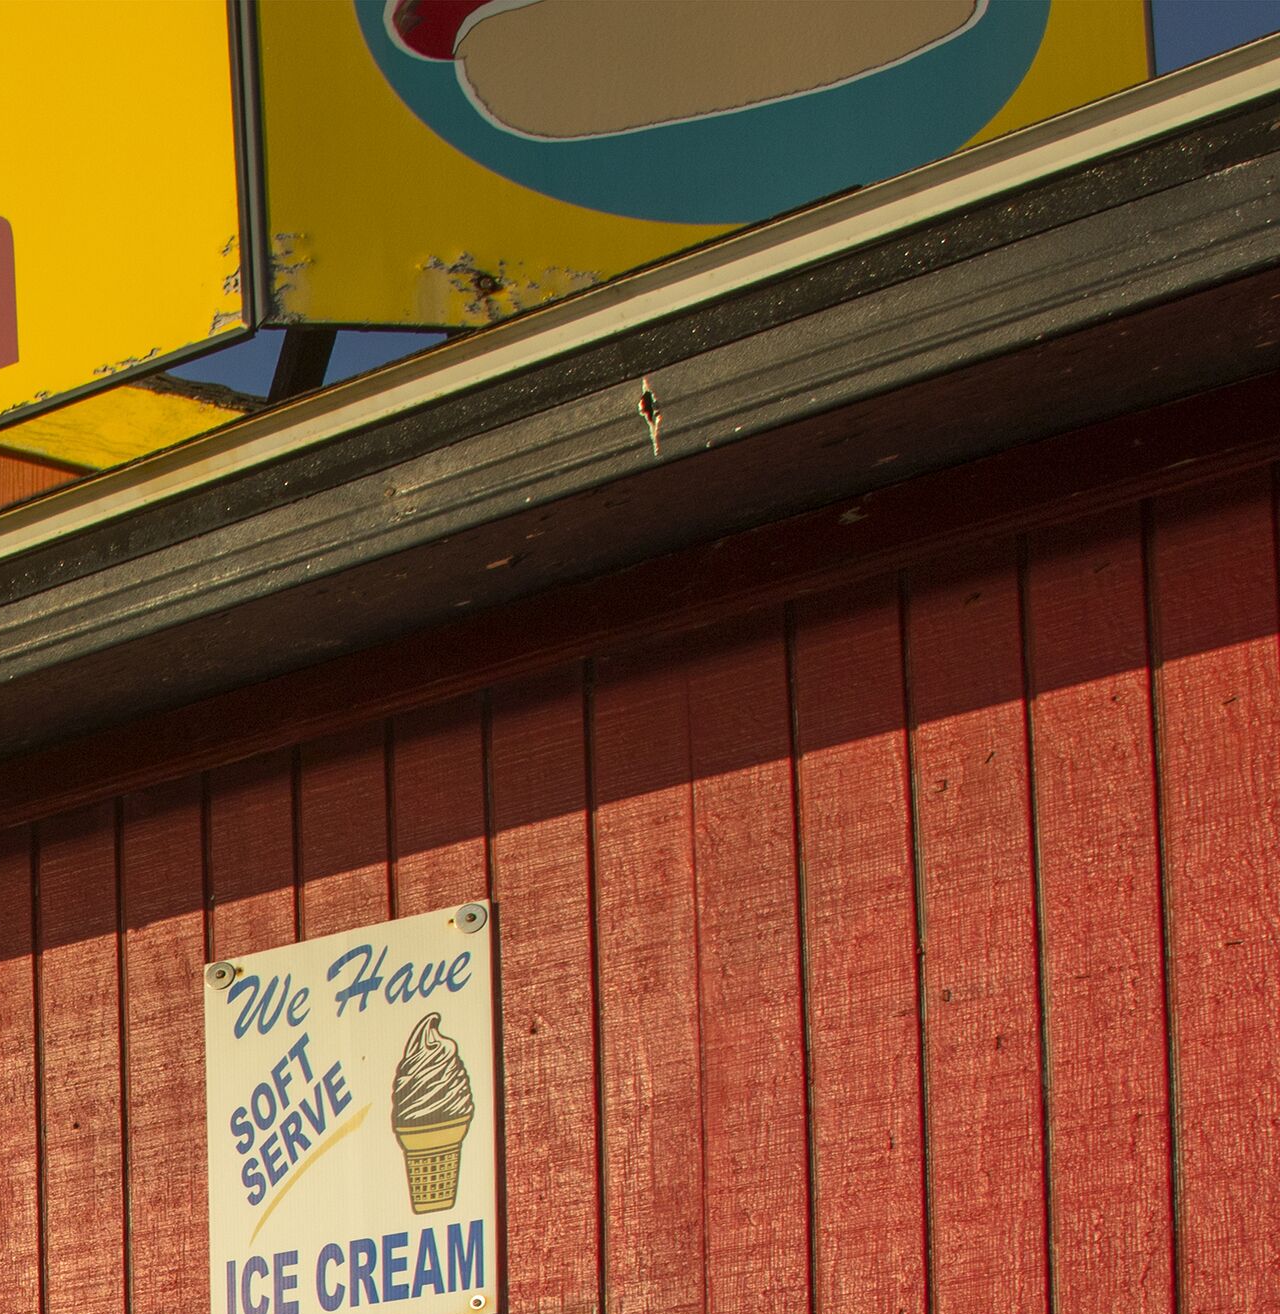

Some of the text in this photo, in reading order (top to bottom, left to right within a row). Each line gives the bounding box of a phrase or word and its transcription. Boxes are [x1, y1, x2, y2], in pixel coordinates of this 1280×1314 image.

[226, 944, 472, 1040] We Have
[229, 1031, 316, 1156] SOFT
[242, 1061, 353, 1207] SERVE
[316, 1218, 485, 1312] CREAM
